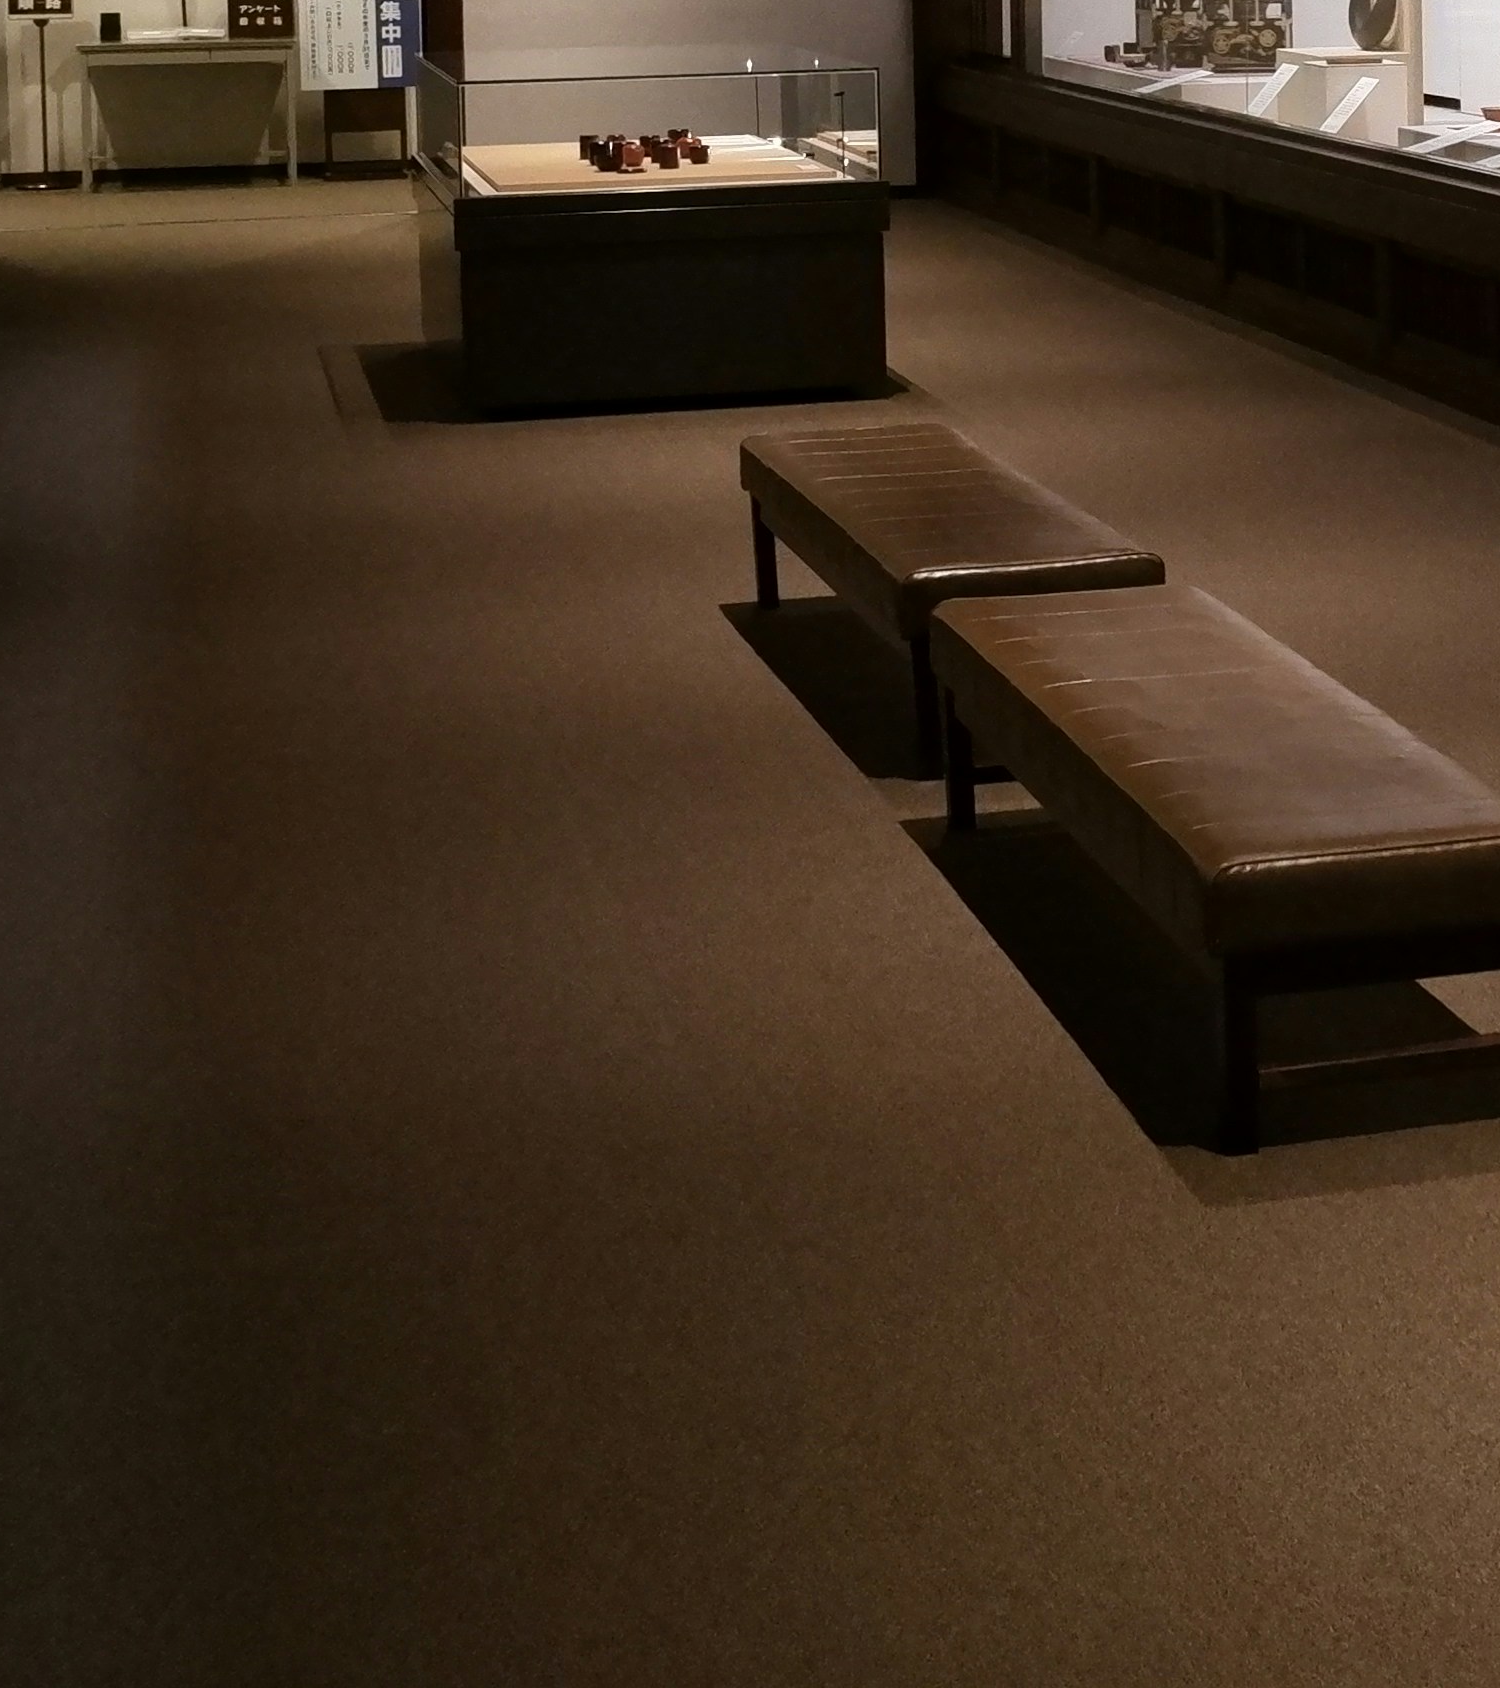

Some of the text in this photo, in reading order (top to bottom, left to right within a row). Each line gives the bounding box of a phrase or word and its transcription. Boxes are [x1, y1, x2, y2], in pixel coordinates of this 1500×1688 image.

[239, 4, 281, 14] アンケート
